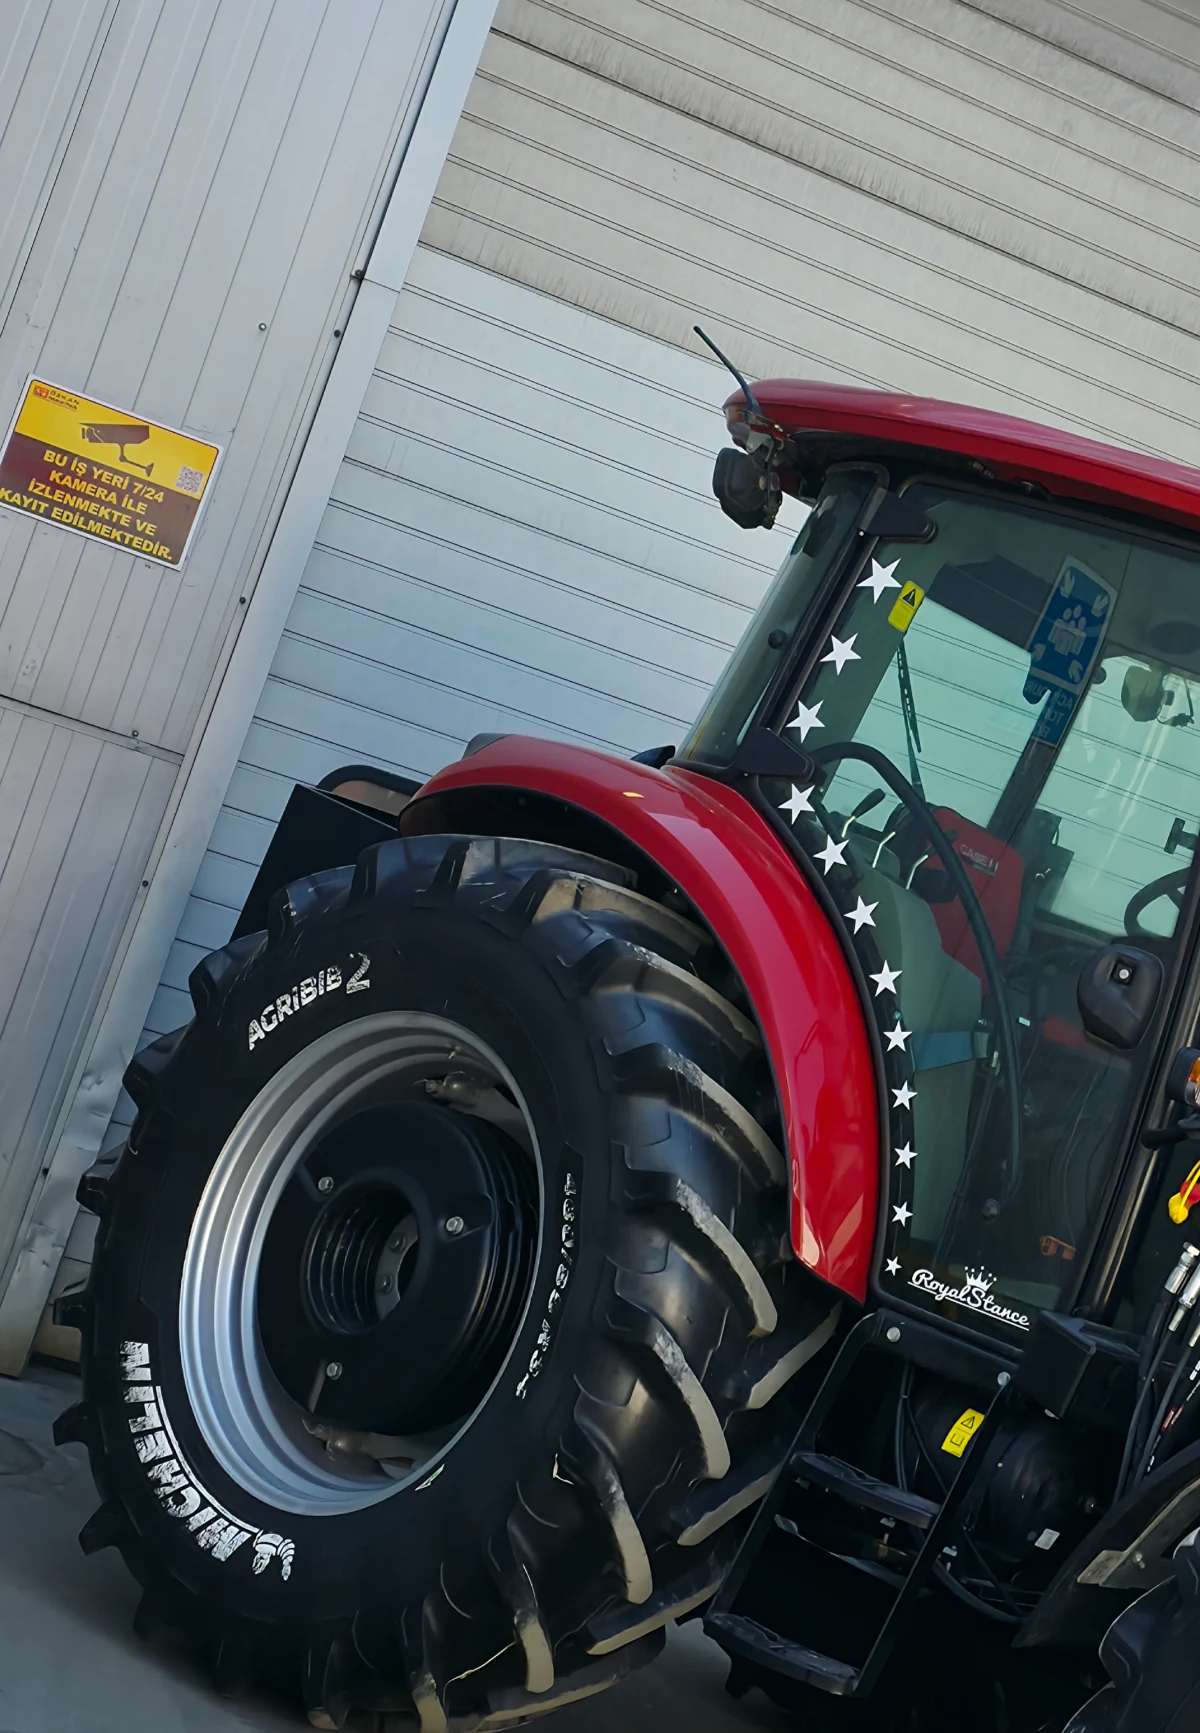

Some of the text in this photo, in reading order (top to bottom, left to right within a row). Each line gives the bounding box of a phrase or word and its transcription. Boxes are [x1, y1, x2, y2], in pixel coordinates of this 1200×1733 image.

[43, 450, 164, 503] BU İŞ YERİ 7/24
[49, 470, 148, 515] KAMERA İLE
[0, 488, 173, 560] KAYIT EDİLMEKTEDİR.
[28, 478, 158, 536] İZLENMEKTE VE
[345, 952, 371, 994] 2
[119, 1340, 252, 1562] MICHELIN
